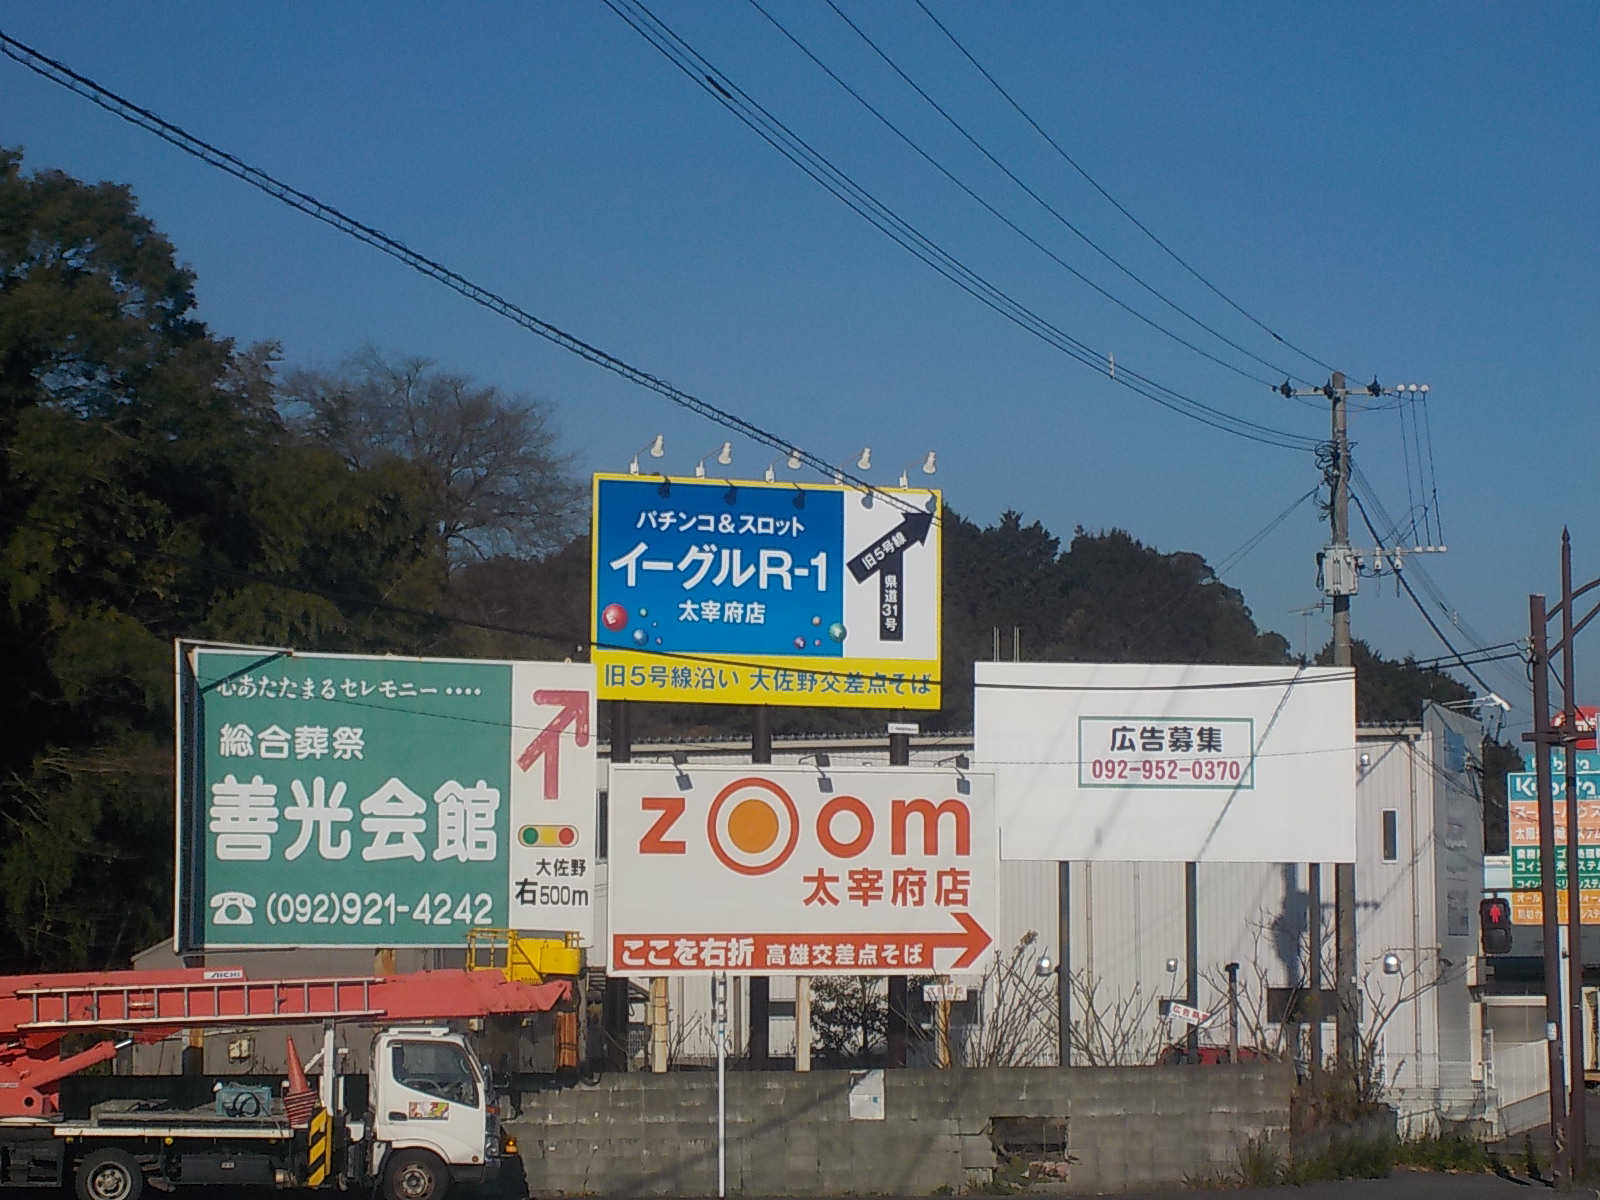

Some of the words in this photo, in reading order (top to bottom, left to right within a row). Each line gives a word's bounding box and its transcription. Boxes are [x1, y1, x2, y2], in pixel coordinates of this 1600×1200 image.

[861, 531, 907, 570] 旧5号線
[678, 599, 766, 625] 太宰府店
[604, 664, 739, 689] 旧5号線沿い
[749, 669, 932, 695] 大佐野交差点そば
[219, 722, 365, 760] 総合葬祭
[1109, 726, 1222, 753] 広告募集
[1092, 759, 1240, 781] 092-952-0370
[209, 774, 500, 863] 善光会館
[535, 858, 587, 878] 大佐野
[514, 878, 589, 908] 右500m
[802, 867, 971, 907] 太宰府店
[266, 891, 493, 926] (092)921-4242
[622, 937, 754, 967] ここを右折
[766, 942, 924, 966] 高雄交差点そば
